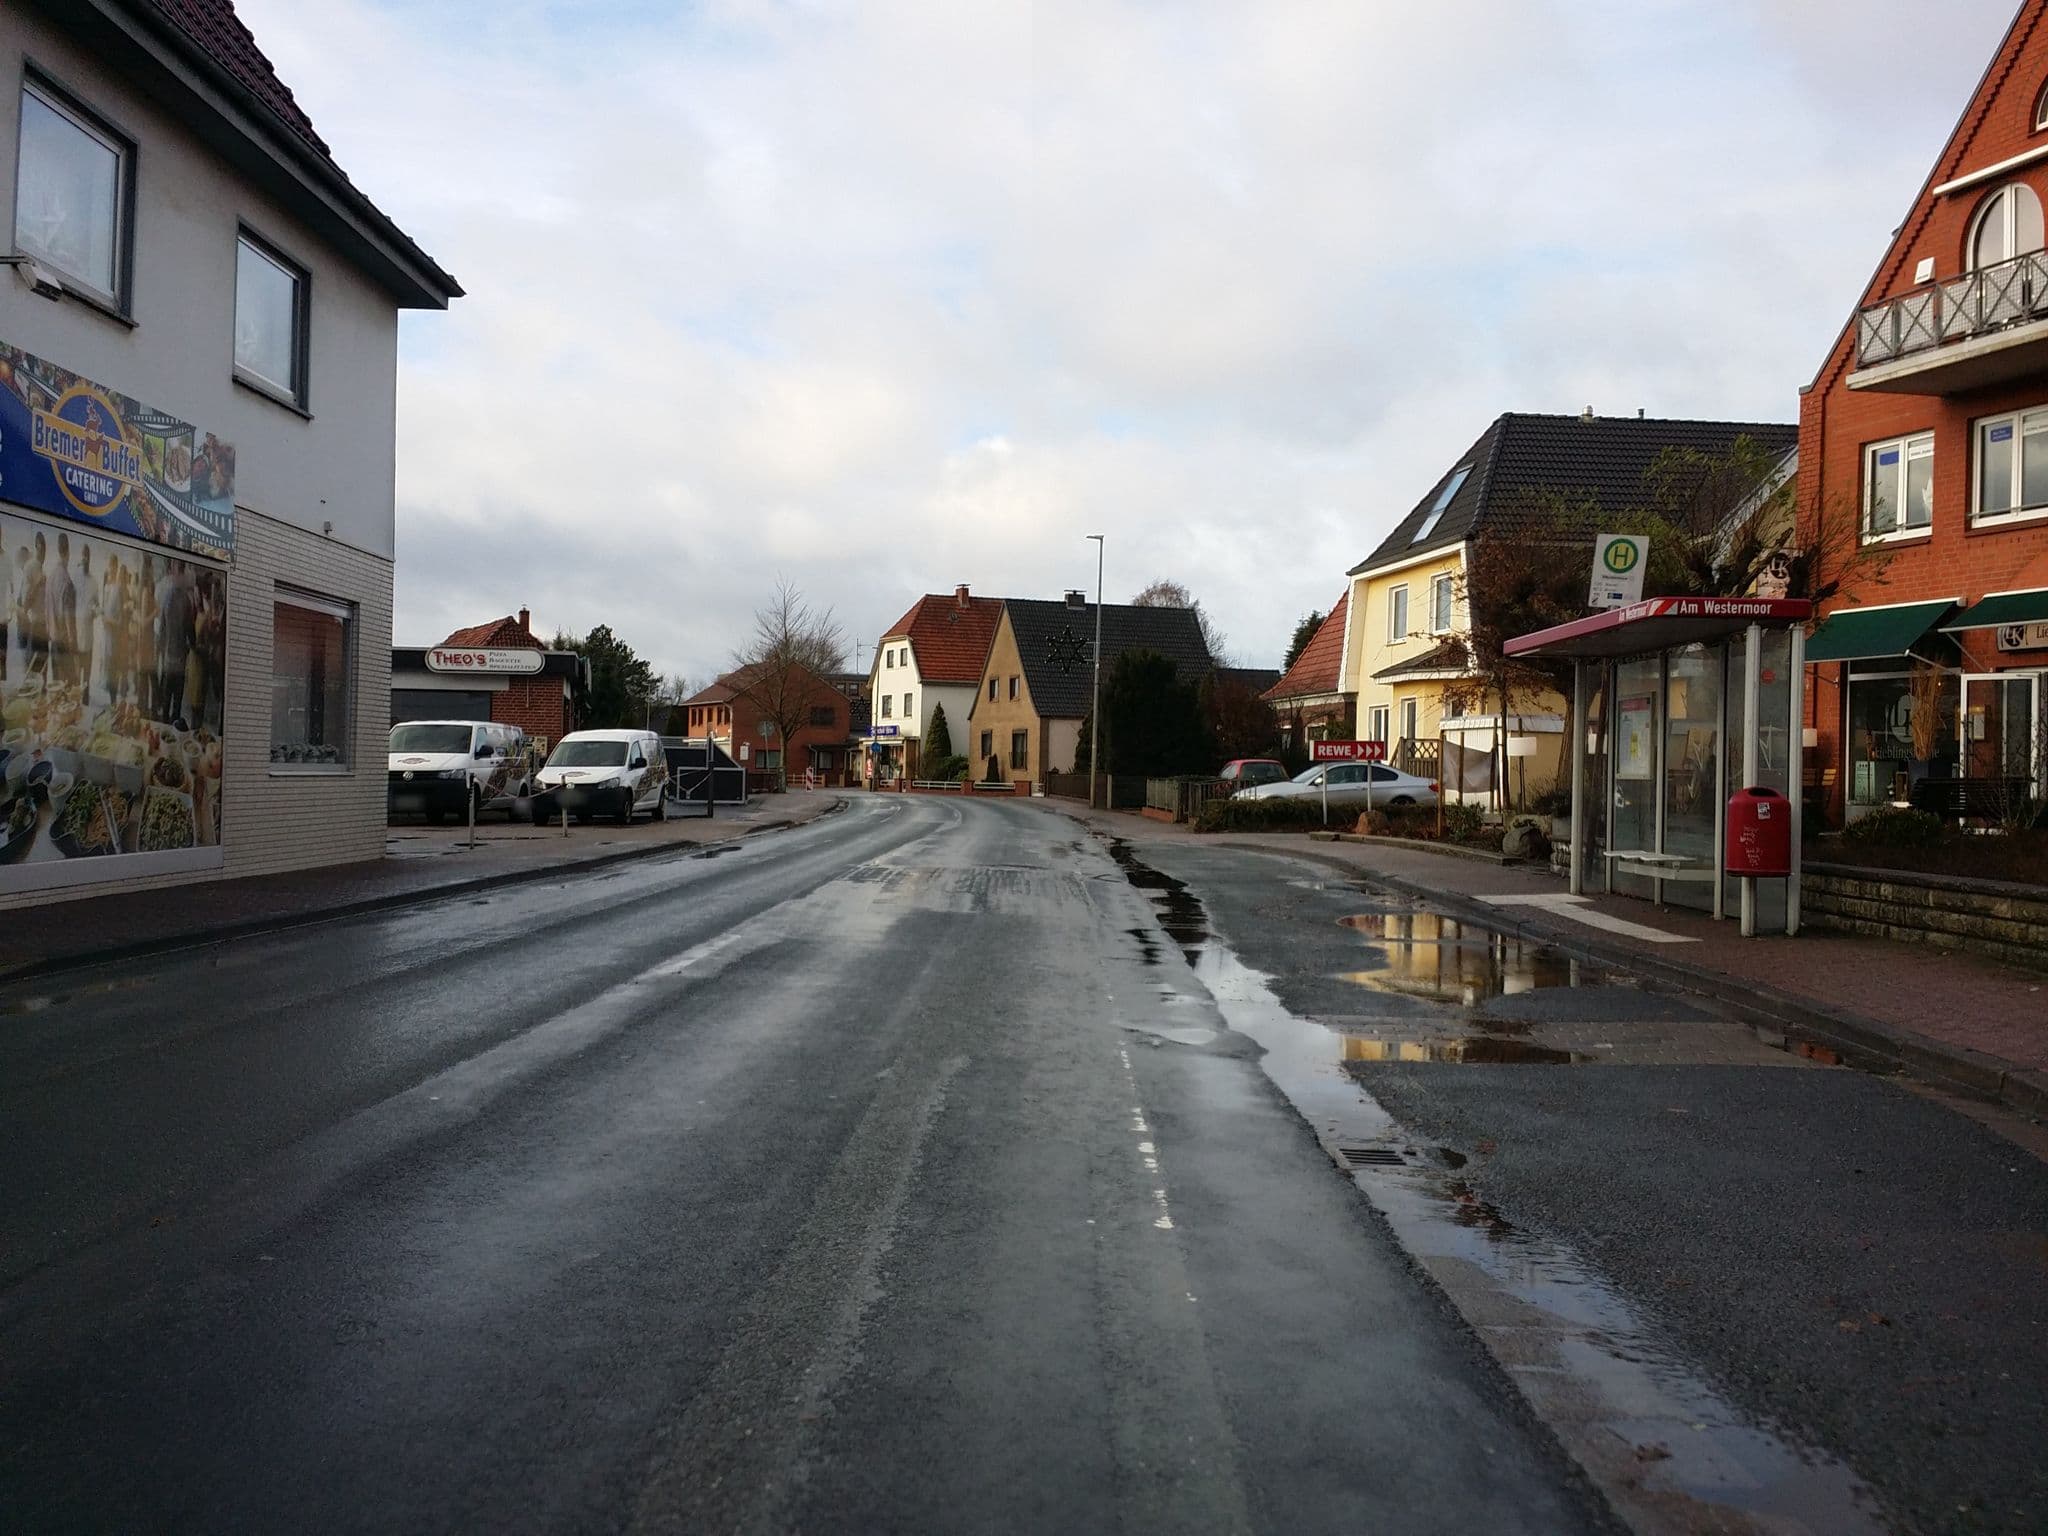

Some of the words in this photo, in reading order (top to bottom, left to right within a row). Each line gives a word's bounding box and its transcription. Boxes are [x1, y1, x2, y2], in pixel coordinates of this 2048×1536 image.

[34, 413, 85, 462] Bremer
[102, 440, 141, 481] Buffet
[65, 467, 113, 497] CATERING
[1613, 545, 1629, 567] H
[1680, 601, 1698, 614] Am
[1704, 601, 1773, 614] Westermoor
[433, 651, 485, 665] THEO'S
[1318, 745, 1352, 756] REWE
